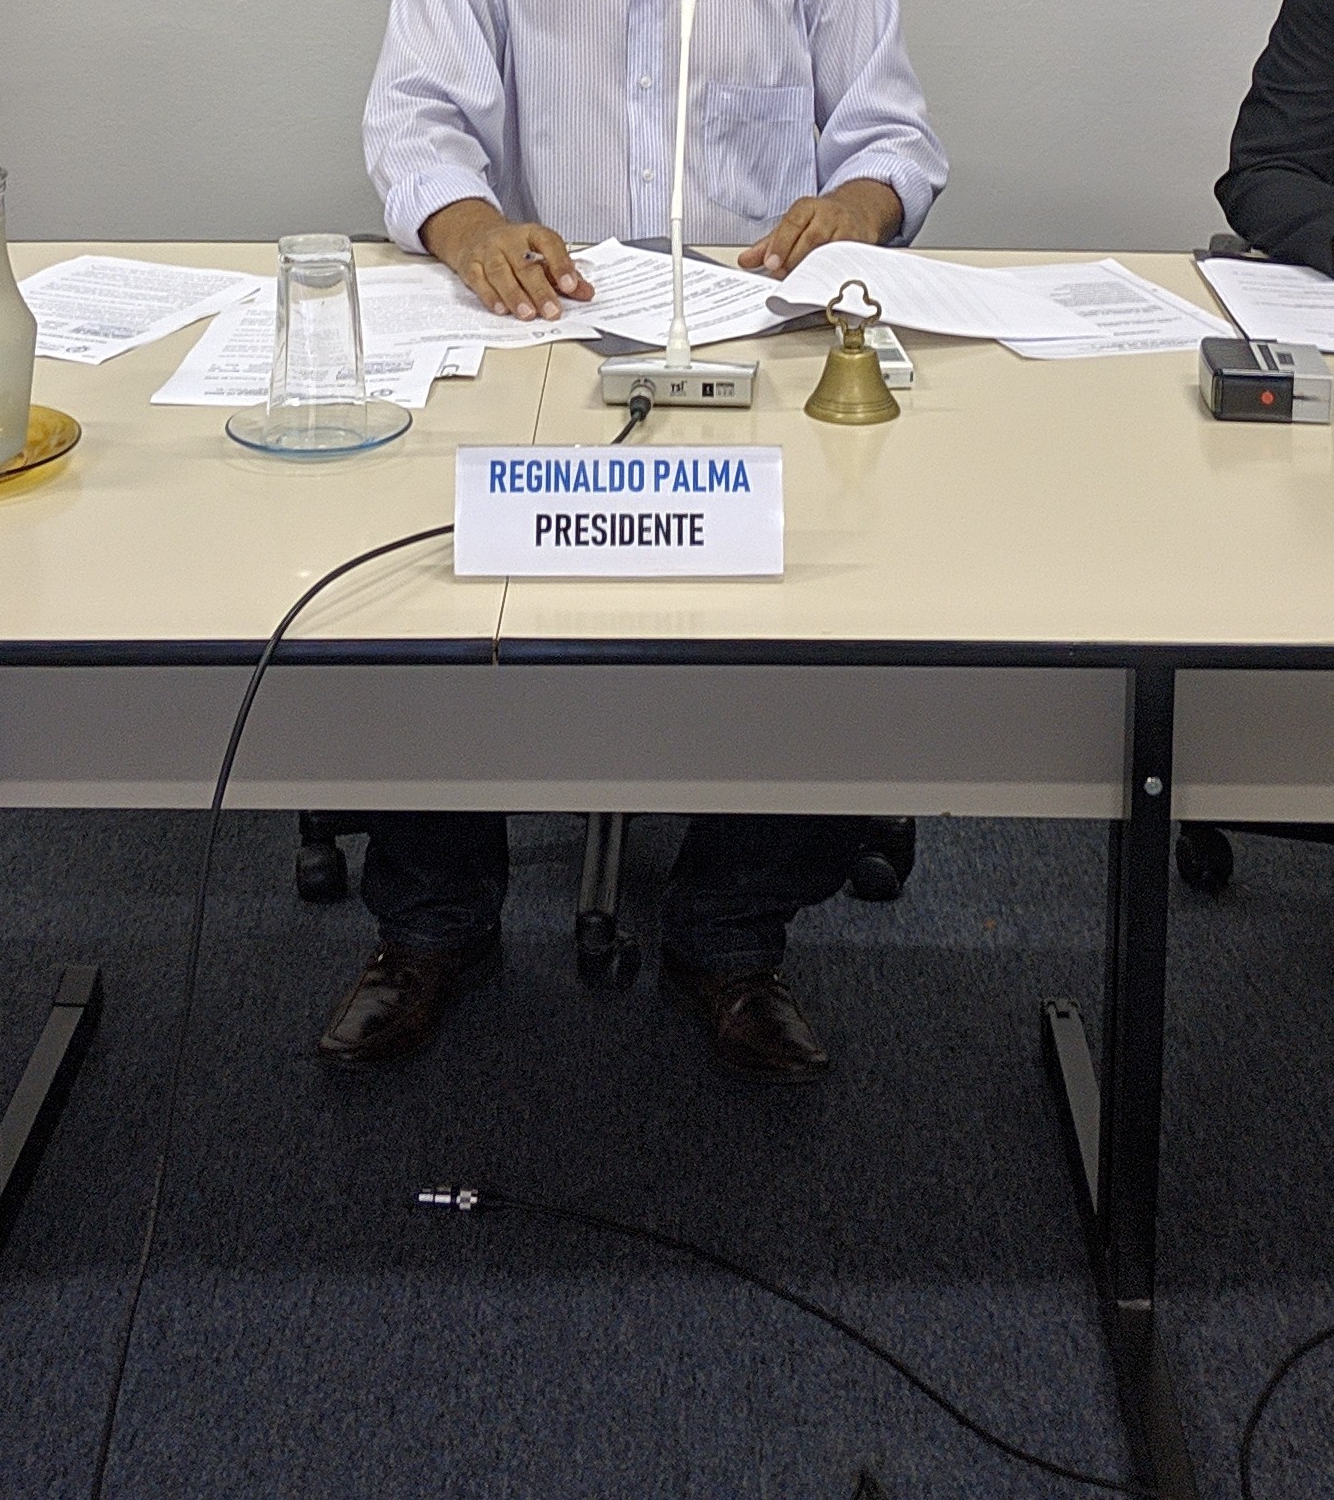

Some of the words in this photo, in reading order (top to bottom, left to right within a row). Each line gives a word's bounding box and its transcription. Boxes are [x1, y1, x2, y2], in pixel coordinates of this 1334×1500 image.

[489, 459, 646, 494] REGINALDO
[653, 459, 752, 494] PALMA
[535, 513, 706, 547] PRESIDENTE
